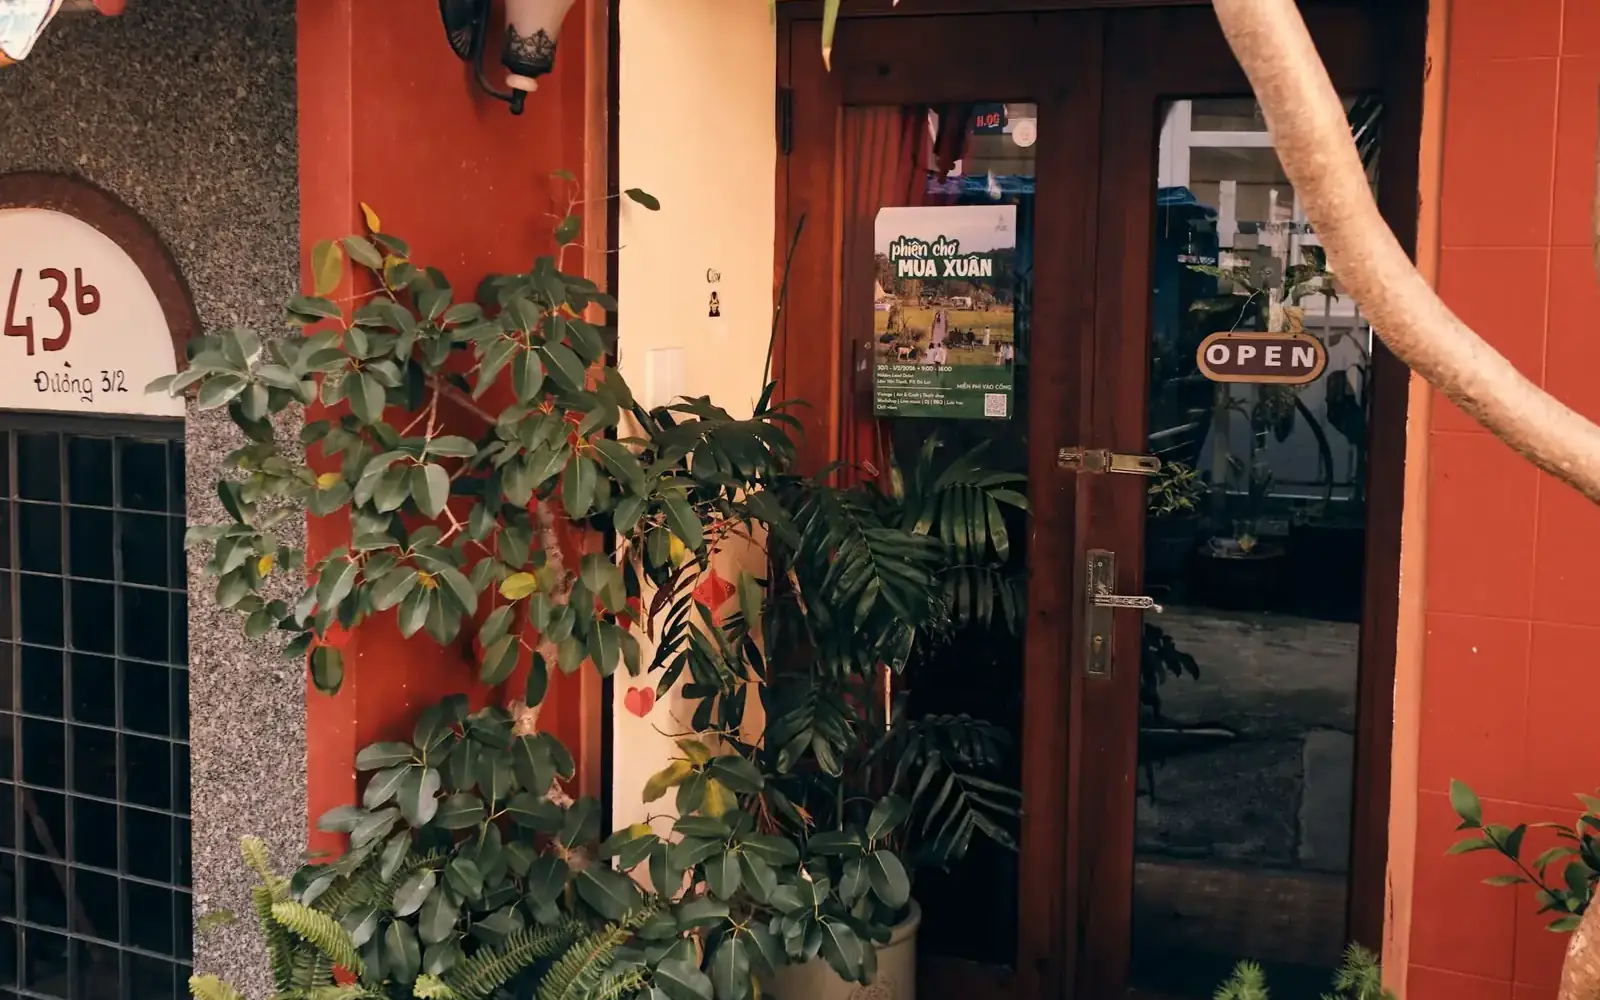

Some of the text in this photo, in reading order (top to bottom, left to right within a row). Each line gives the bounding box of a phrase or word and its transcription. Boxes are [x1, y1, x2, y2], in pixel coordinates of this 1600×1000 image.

[891, 238, 957, 261] phiên chợ
[898, 254, 992, 277] MÙA XUÂN
[1206, 344, 1315, 368] OPEN
[100, 370, 128, 392] 3/2
